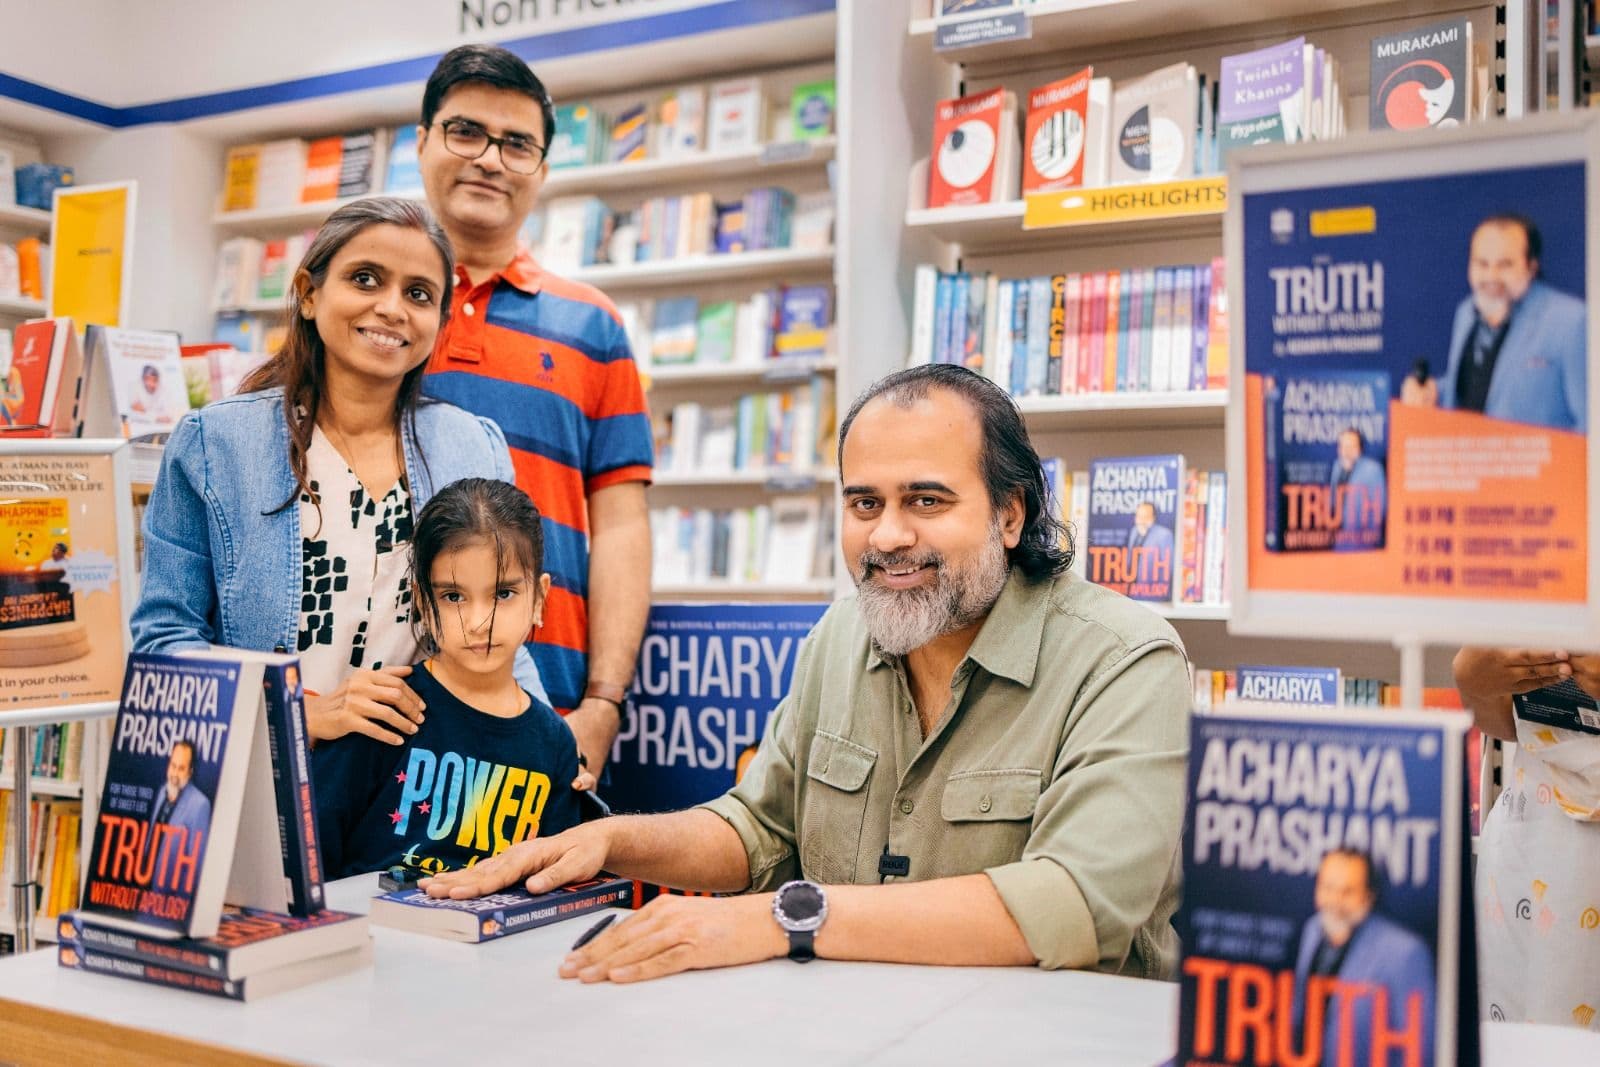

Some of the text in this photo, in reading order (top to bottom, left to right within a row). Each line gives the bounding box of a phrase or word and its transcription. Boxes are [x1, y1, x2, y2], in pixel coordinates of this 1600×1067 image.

[460, 0, 538, 34] Non
[1377, 28, 1458, 58] MURAKAMI
[1235, 60, 1292, 85] Twinkle
[1235, 84, 1292, 104] Khanna
[1091, 184, 1227, 211] HIGHLIGHTS
[1269, 260, 1384, 315] TRUTH
[1092, 466, 1167, 491] ACHARYA
[1282, 484, 1384, 530] TRUTH
[1088, 546, 1171, 584] TRUTH
[19, 676, 45, 688] your
[631, 635, 806, 699] CHARY
[125, 671, 219, 719] ACHARYA
[1241, 676, 1323, 702] ACHARYA
[612, 705, 775, 771] PRASH
[1196, 738, 1409, 813] ACHARYA
[394, 747, 551, 856] POWER
[97, 814, 203, 894] TRUTH
[90, 881, 190, 921] WITHOUT APOLOGY
[505, 914, 530, 927] ACHARYA
[530, 907, 557, 920] PRASHANT
[1182, 957, 1424, 1067] TRUTH
